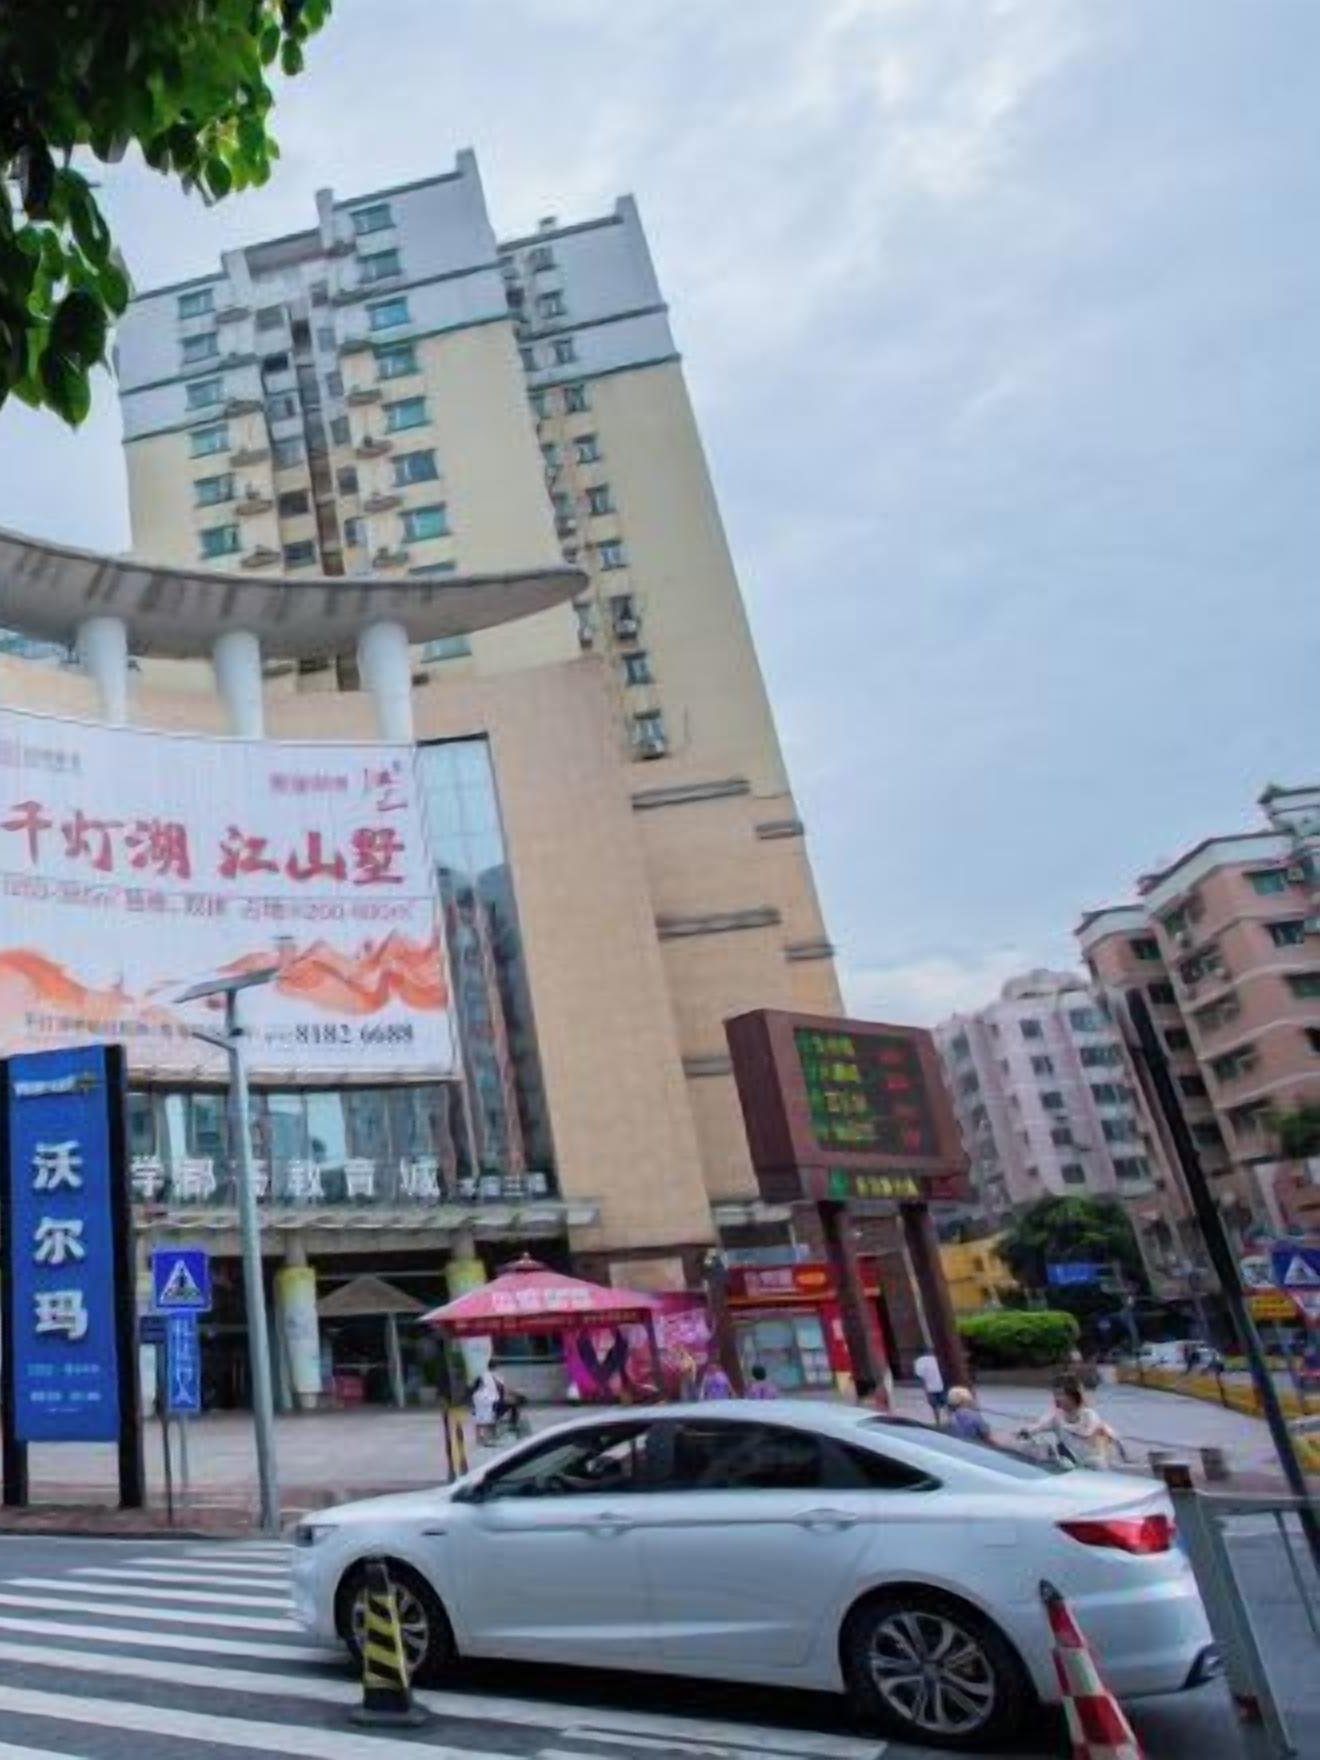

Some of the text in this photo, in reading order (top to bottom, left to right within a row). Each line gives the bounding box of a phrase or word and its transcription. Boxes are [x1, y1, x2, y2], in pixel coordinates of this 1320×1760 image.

[0, 800, 406, 884] 千灯湖 江山墅
[32, 1140, 88, 1339] 沃尔玛
